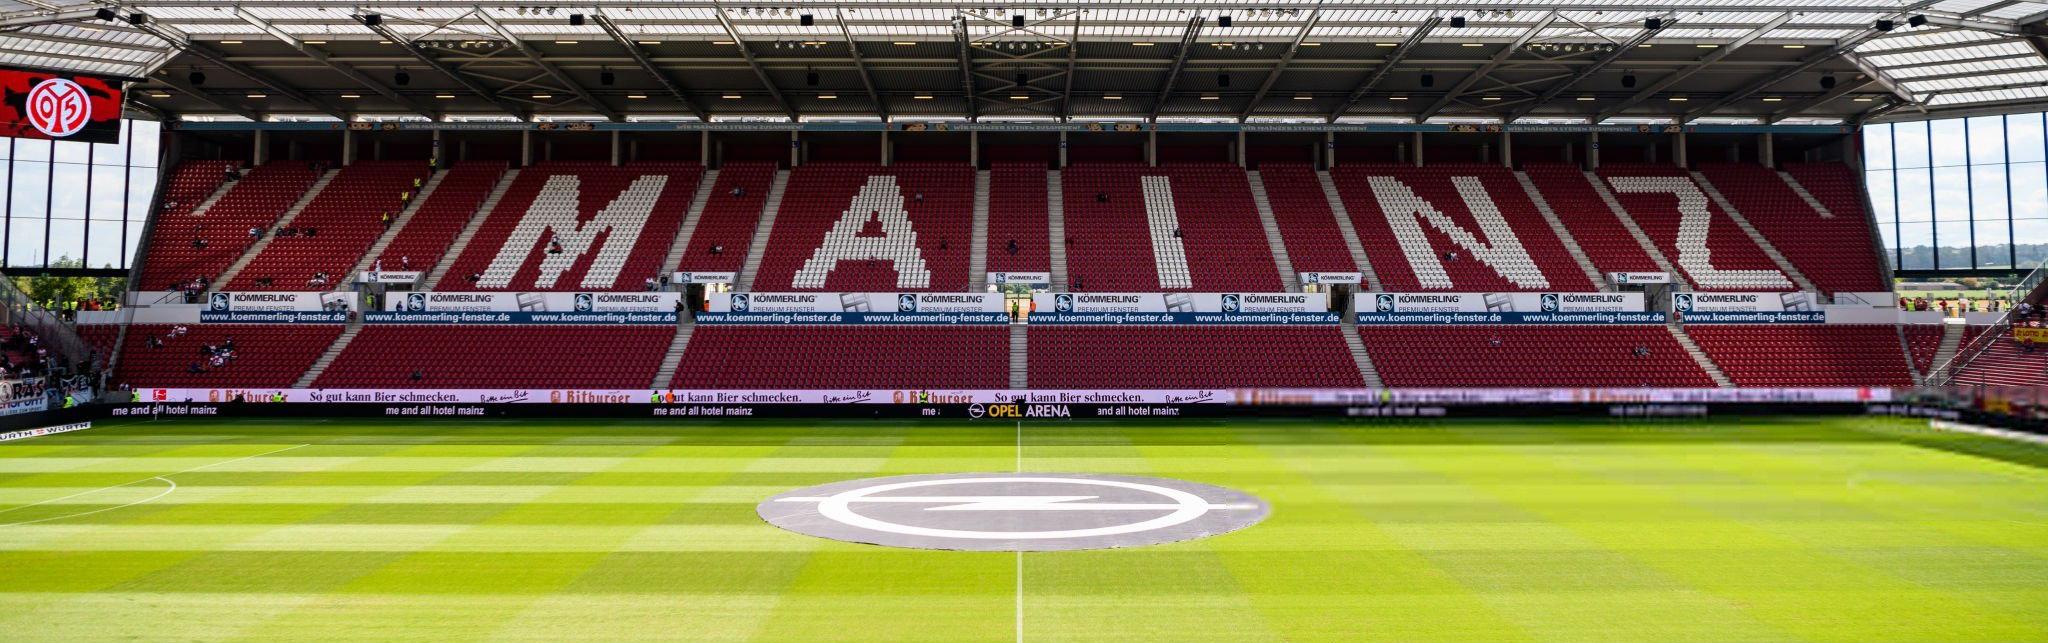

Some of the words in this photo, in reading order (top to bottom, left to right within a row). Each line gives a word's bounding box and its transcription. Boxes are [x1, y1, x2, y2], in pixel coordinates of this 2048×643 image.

[234, 293, 295, 302] KÖMMERLING
[430, 293, 491, 302] KÖMMERLING
[597, 293, 658, 302] KÖMMERLING
[754, 293, 815, 302] KÖMMERLING
[921, 293, 982, 302] KÖMMERLING
[1078, 293, 1139, 302] KÖMMERLING
[1244, 293, 1305, 302] KÖMMERLING
[1398, 293, 1459, 302] KÖMMERLING
[1563, 293, 1623, 302] KÖMMERLING
[1697, 293, 1756, 302] KÖMMERLING
[202, 313, 345, 323] www.koemmerling-fenster.de
[366, 313, 510, 323] www.koemmerling-fenster.de
[532, 313, 676, 323] www.koemmerling-fenster.de
[697, 313, 842, 323] www.koemmerling-fenster.de
[864, 313, 1008, 323] www.koemmerling-fenster.de
[1029, 313, 1173, 323] www.koemmerling-fenster.de
[1195, 313, 1339, 323] www.koemmerling-fenster.de
[1359, 313, 1501, 323] www.koemmerling-fenster.de
[1523, 313, 1664, 323] www.koemmerling-fenster.de
[1685, 313, 1824, 323] www.koemmerling-fenster.de
[310, 393, 322, 402] So
[326, 394, 342, 403] gut
[345, 393, 371, 402] kann
[375, 393, 396, 402] Bier
[399, 393, 459, 402] schmecken.
[567, 391, 630, 403] Bitburger
[688, 393, 715, 402] kann
[717, 393, 739, 402] Bier
[742, 393, 802, 402] schmecken.
[995, 393, 1007, 402] So
[1031, 393, 1056, 402] kann
[1060, 393, 1081, 402] Bier
[1084, 393, 1144, 402] schmecken.
[131, 405, 149, 414] and
[166, 405, 188, 414] hotel
[191, 405, 217, 414] mainz
[401, 406, 418, 415] and
[420, 406, 431, 415] all
[433, 406, 455, 415] hotel
[458, 406, 484, 415] mainz
[670, 406, 686, 415] and
[689, 406, 699, 415] all
[701, 406, 723, 415] hotel
[726, 406, 752, 415] mainz
[989, 405, 1022, 417] OPEL
[1025, 405, 1071, 417] ARENA
[1098, 406, 1113, 415] and
[1116, 406, 1125, 415] all
[1129, 406, 1150, 415] hotel
[46, 423, 88, 433] WÜRTH
[0, 431, 32, 440] ÜRTH
